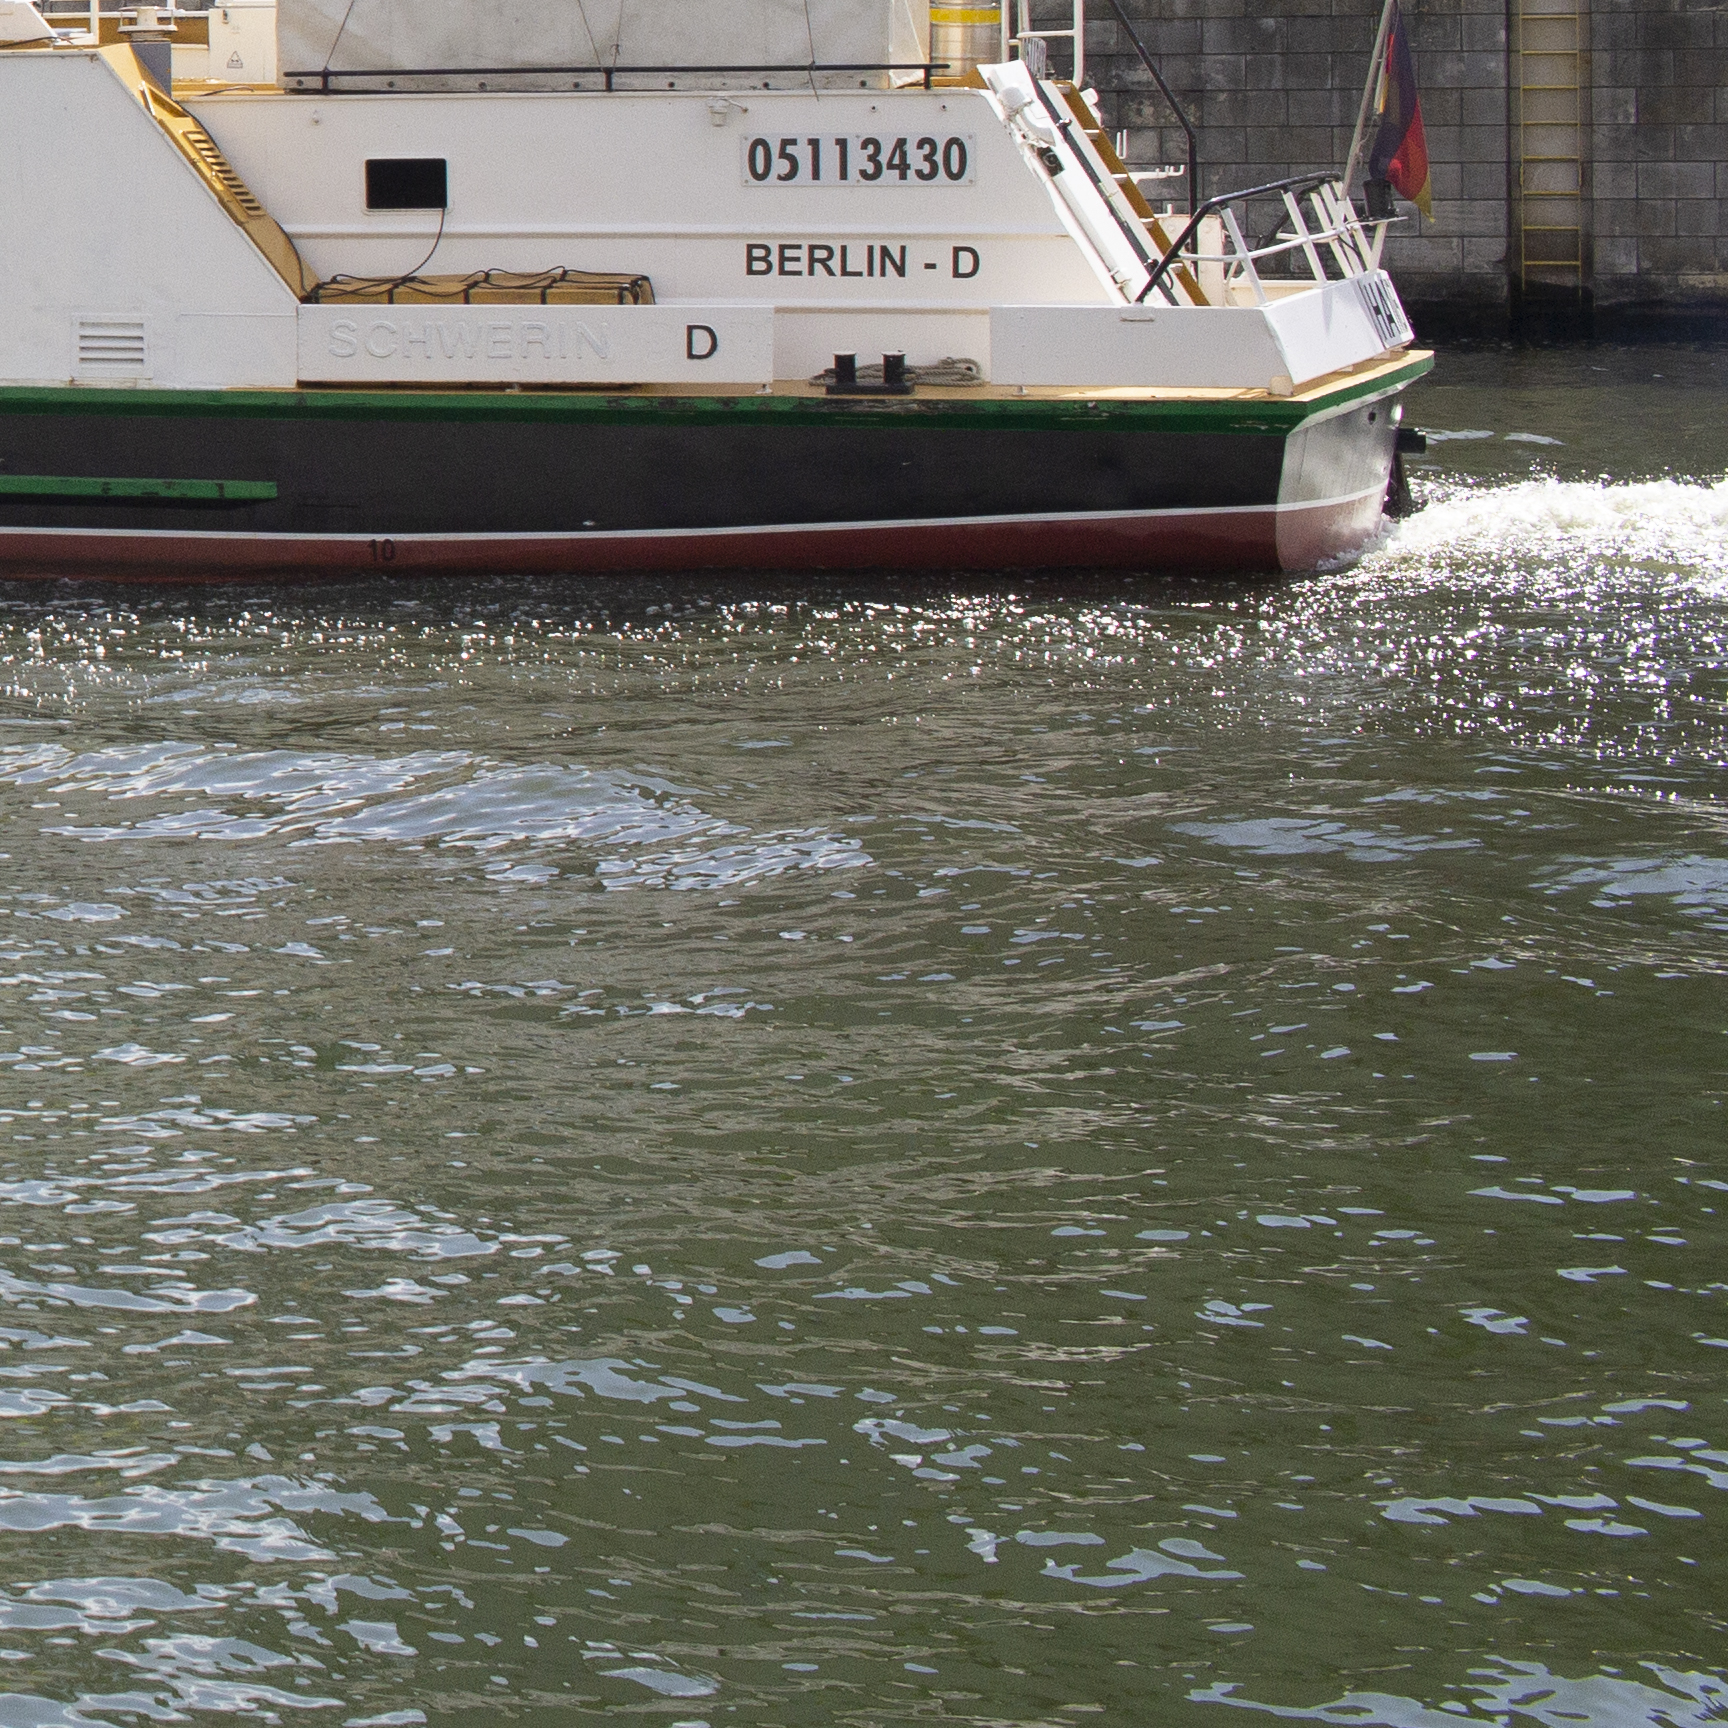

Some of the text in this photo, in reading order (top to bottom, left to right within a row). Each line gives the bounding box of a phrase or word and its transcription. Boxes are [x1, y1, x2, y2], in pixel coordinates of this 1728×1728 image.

[747, 137, 968, 182] 05113430
[745, 243, 907, 278] BERLIN
[951, 246, 981, 279] D
[328, 319, 612, 360] SCHWERIN
[685, 324, 718, 360] D
[367, 538, 396, 562] 10
